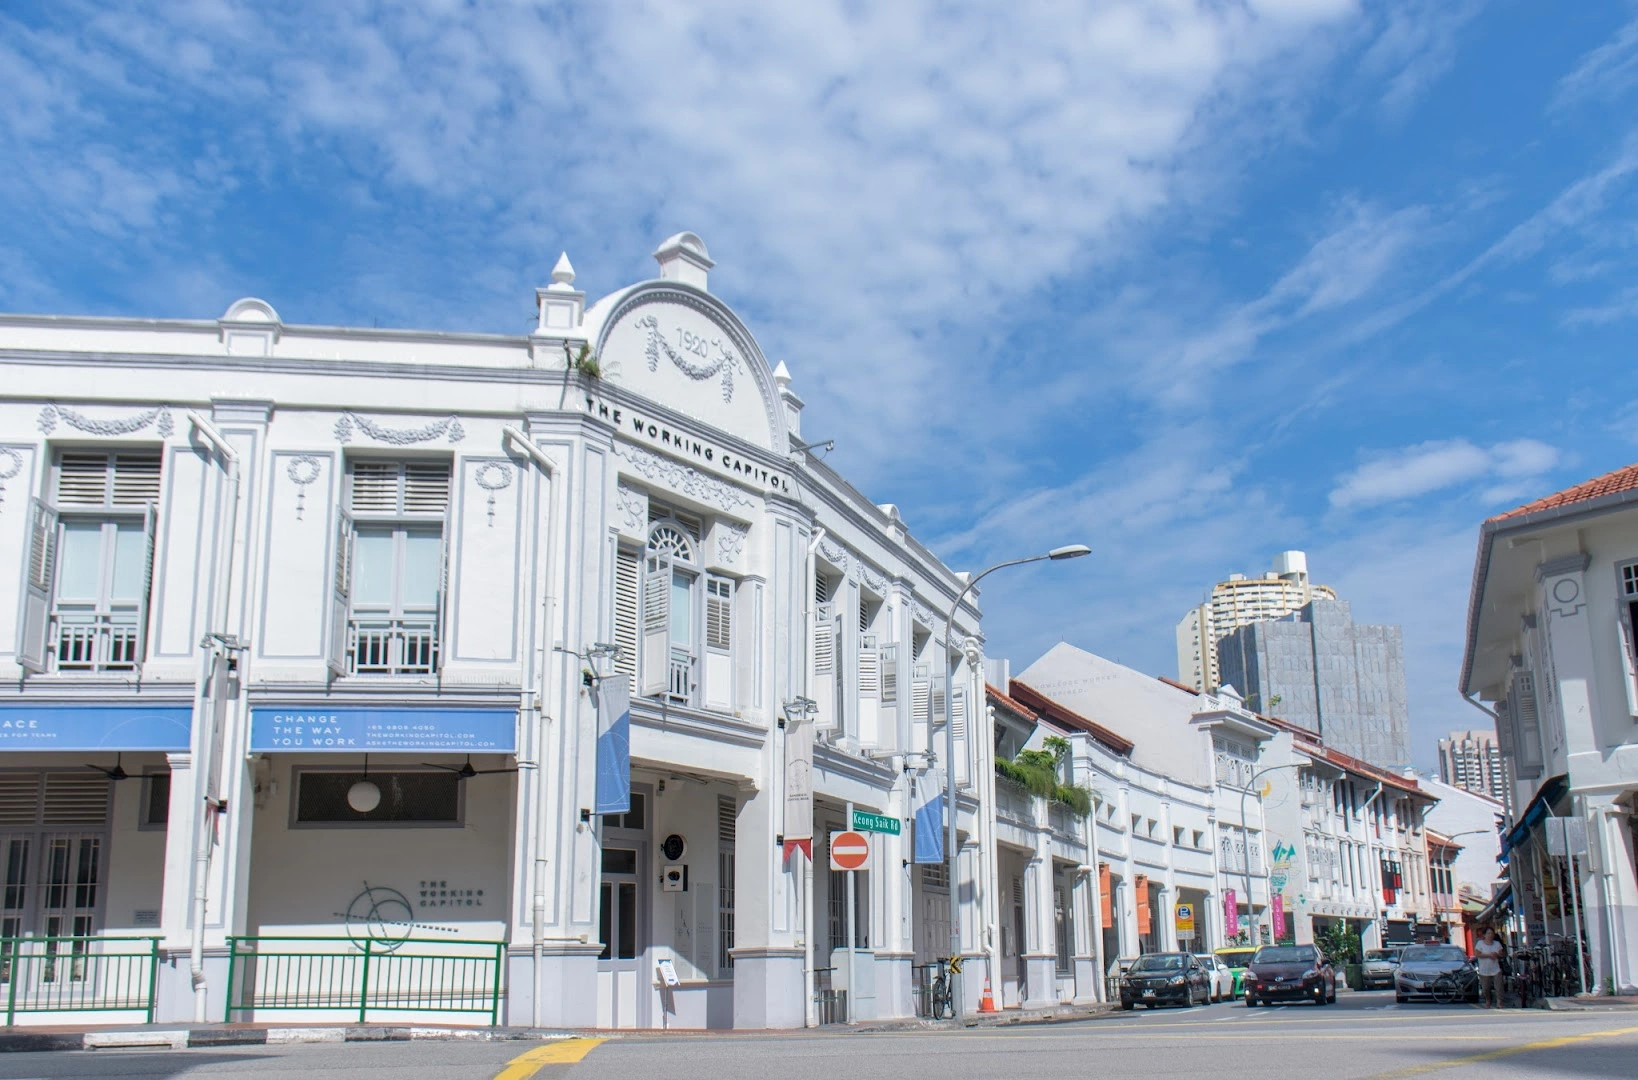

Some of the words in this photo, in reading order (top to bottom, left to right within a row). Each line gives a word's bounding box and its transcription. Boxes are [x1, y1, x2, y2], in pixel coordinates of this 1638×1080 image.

[676, 328, 708, 358] 1920
[586, 398, 621, 425] THE
[633, 417, 713, 461] WORKING
[722, 455, 788, 493] CAPITOL
[1034, 679, 1079, 689] NOWLEDGE
[273, 715, 338, 724] CHANGE
[273, 726, 304, 734] THE
[311, 726, 342, 734] WAY
[272, 738, 304, 746] YOU
[311, 738, 356, 746] WORK
[853, 812, 874, 829] Keong
[875, 816, 889, 829] Saik
[890, 819, 899, 831] Rd
[420, 880, 447, 888] THE
[420, 890, 484, 898] WORKING
